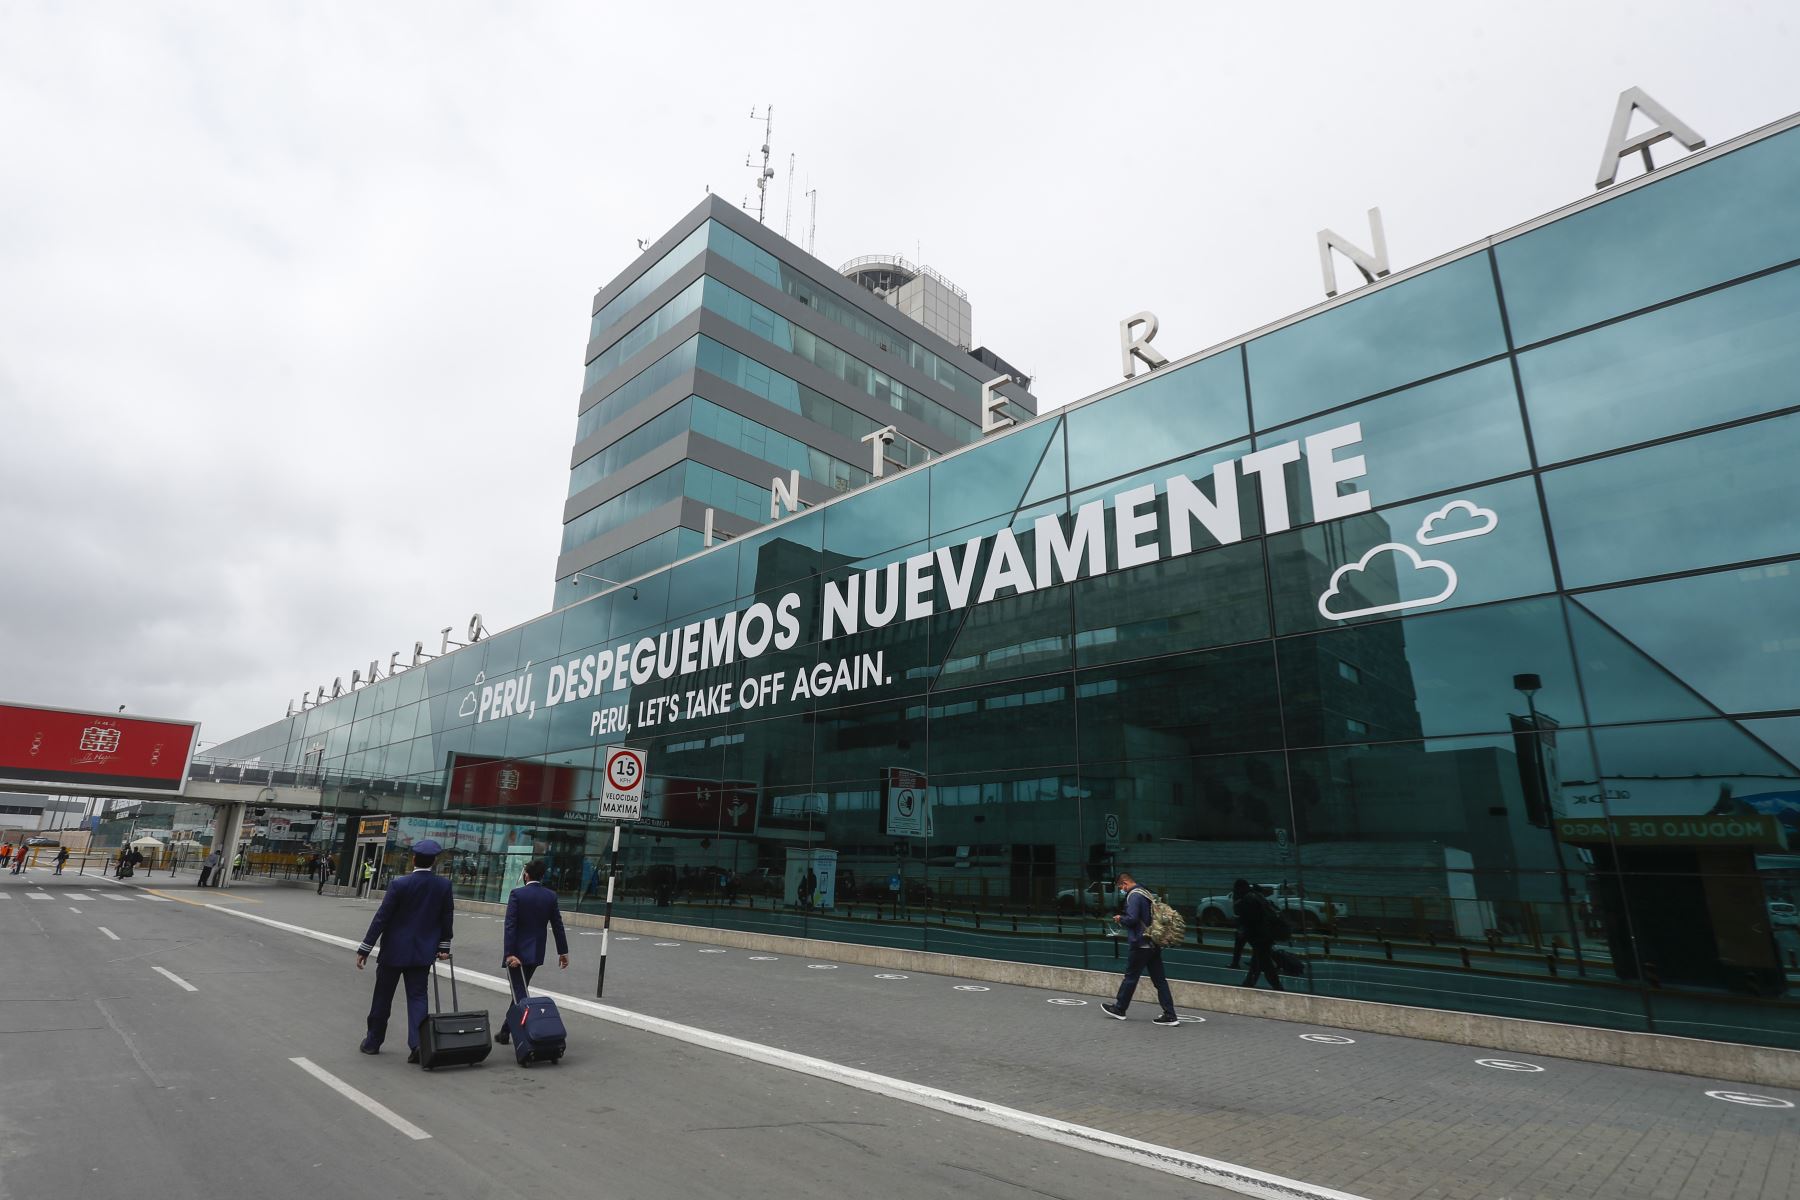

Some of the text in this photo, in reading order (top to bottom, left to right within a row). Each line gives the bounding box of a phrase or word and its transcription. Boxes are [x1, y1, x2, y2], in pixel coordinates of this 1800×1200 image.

[477, 421, 1372, 723] PERÚ, DESPEGUEMOS NUEVAMENTE
[590, 651, 892, 737] PERU, LET'S TAKE OFF AGAIN.
[617, 760, 635, 776] 15
[606, 793, 639, 802] VELOCIDAD
[603, 803, 638, 814] MAXIMA
